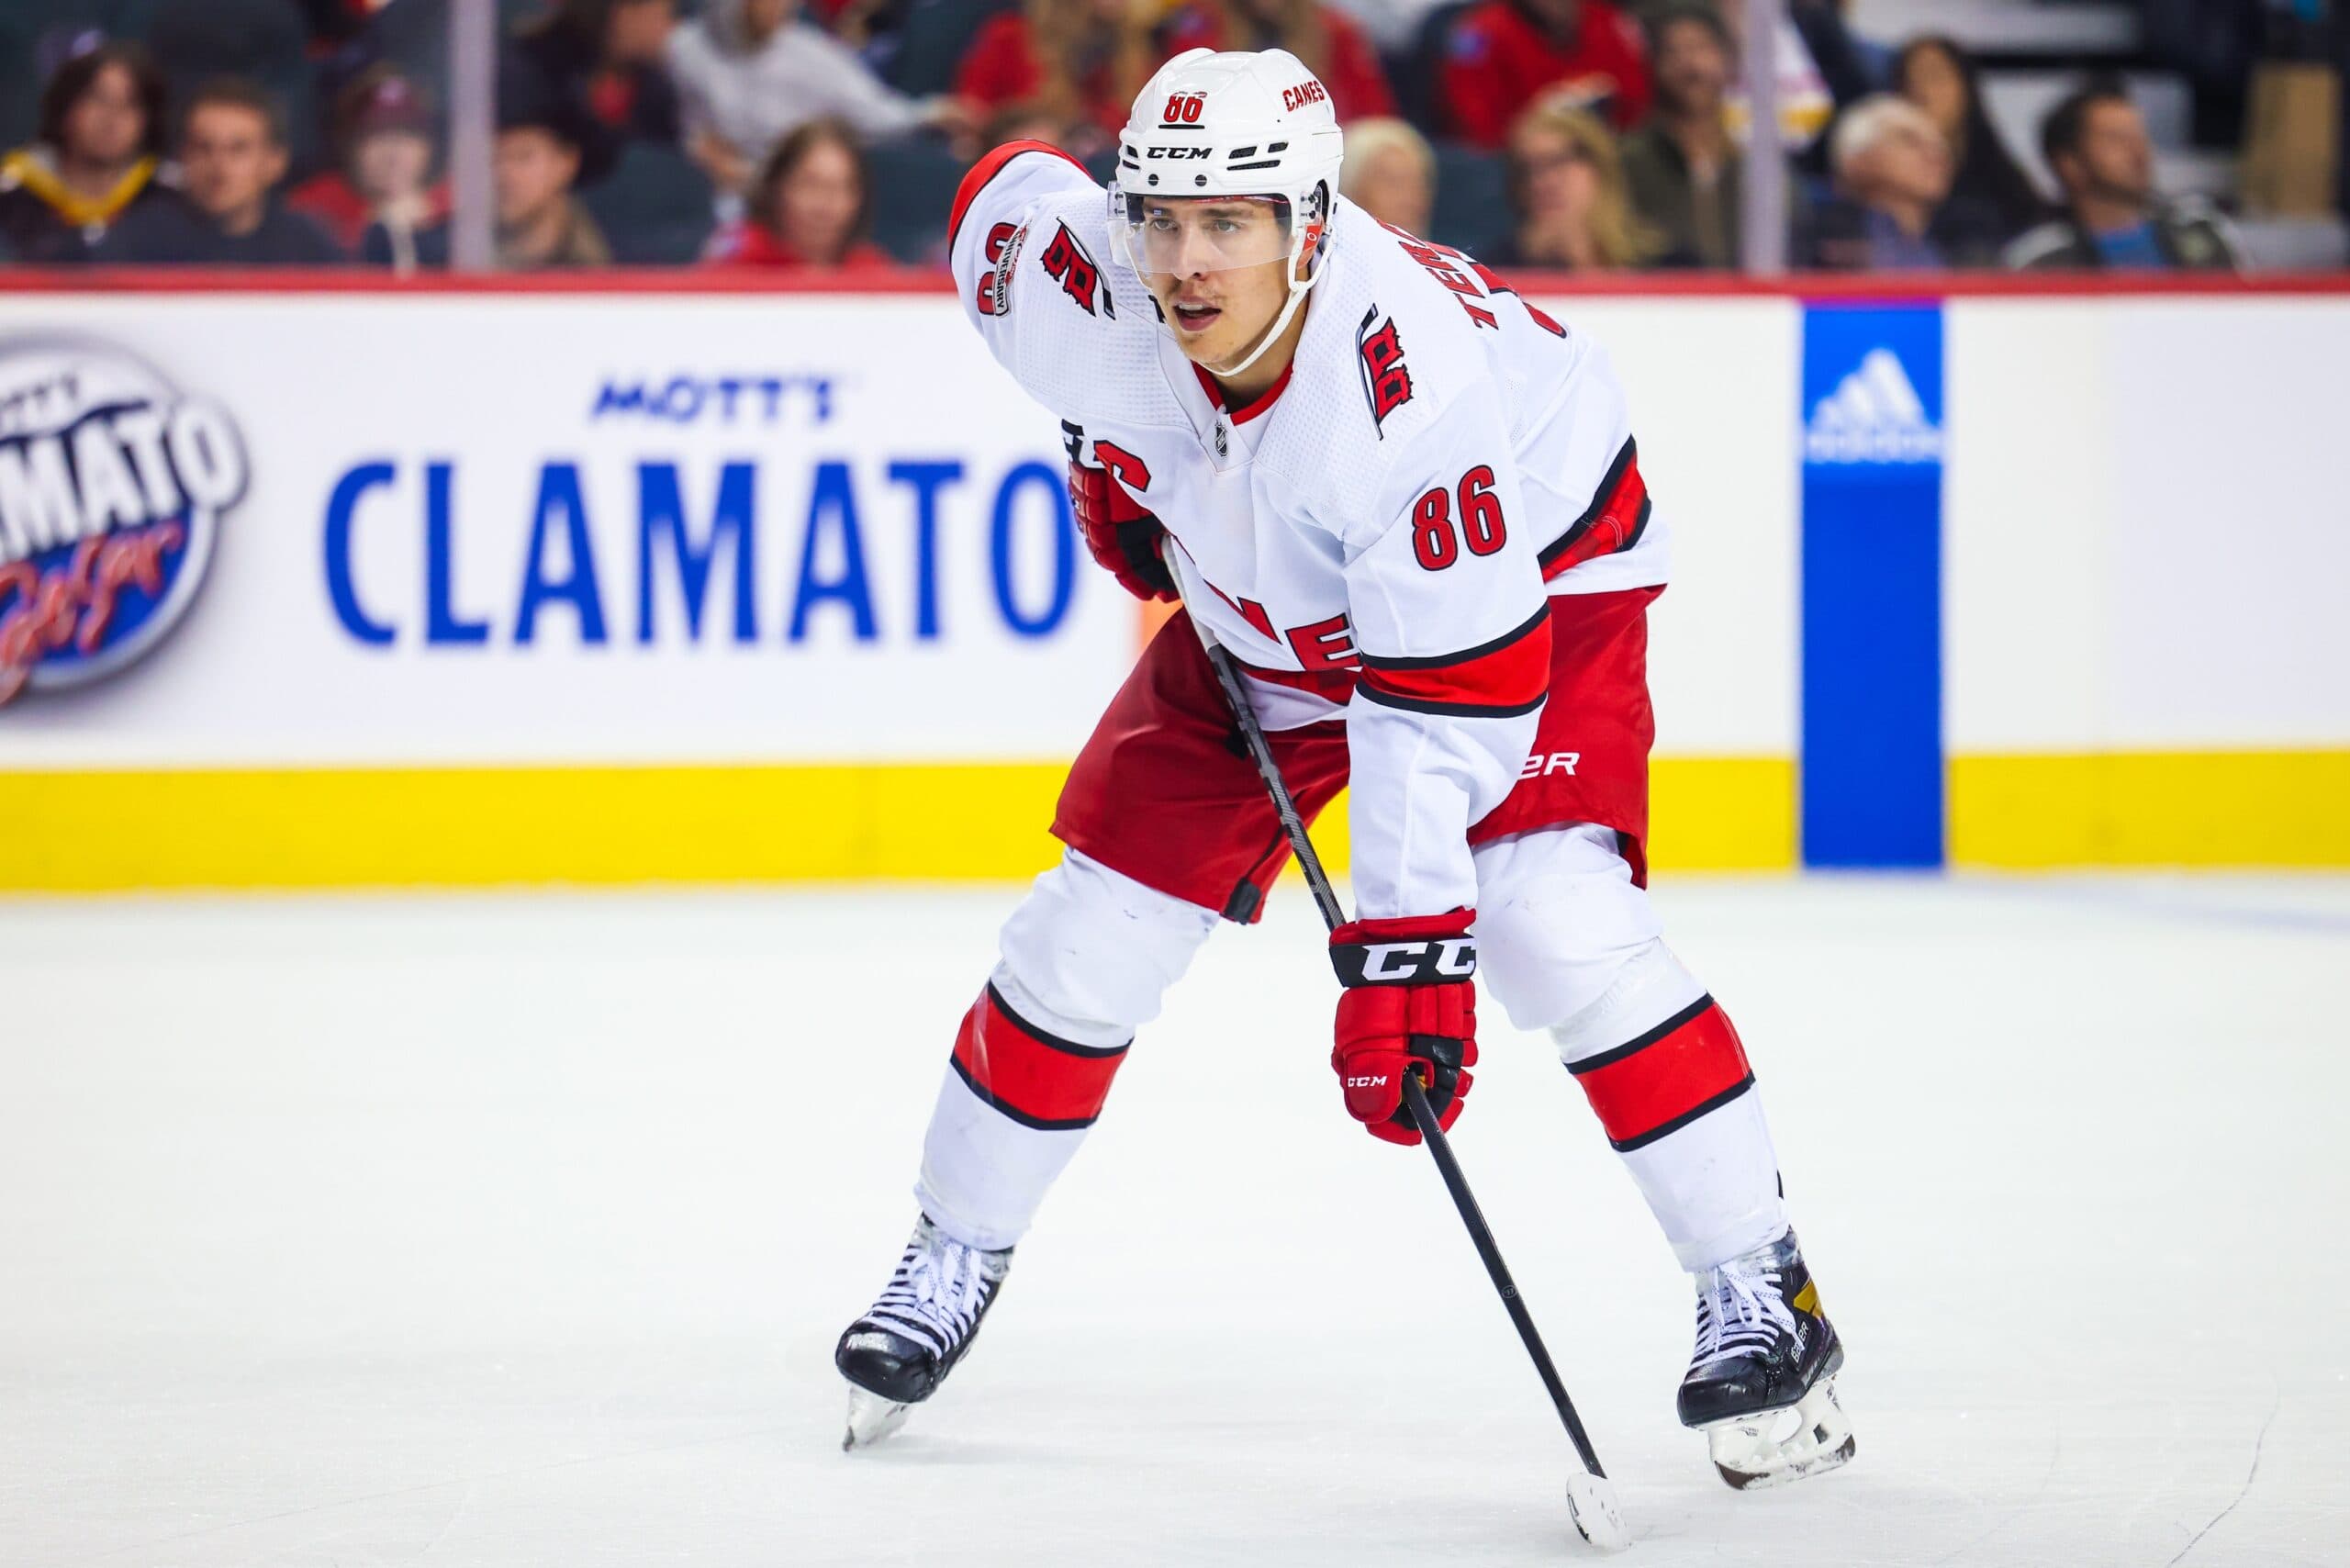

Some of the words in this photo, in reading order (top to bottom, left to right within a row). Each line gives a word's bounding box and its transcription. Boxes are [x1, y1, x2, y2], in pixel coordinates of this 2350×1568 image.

[1162, 91, 1208, 124] 86
[1281, 79, 1326, 113] CANES
[1147, 146, 1214, 161] CCM
[1411, 464, 1507, 571] 86
[321, 458, 1078, 645] CLAMATO
[1348, 1075, 1387, 1088] CCM
